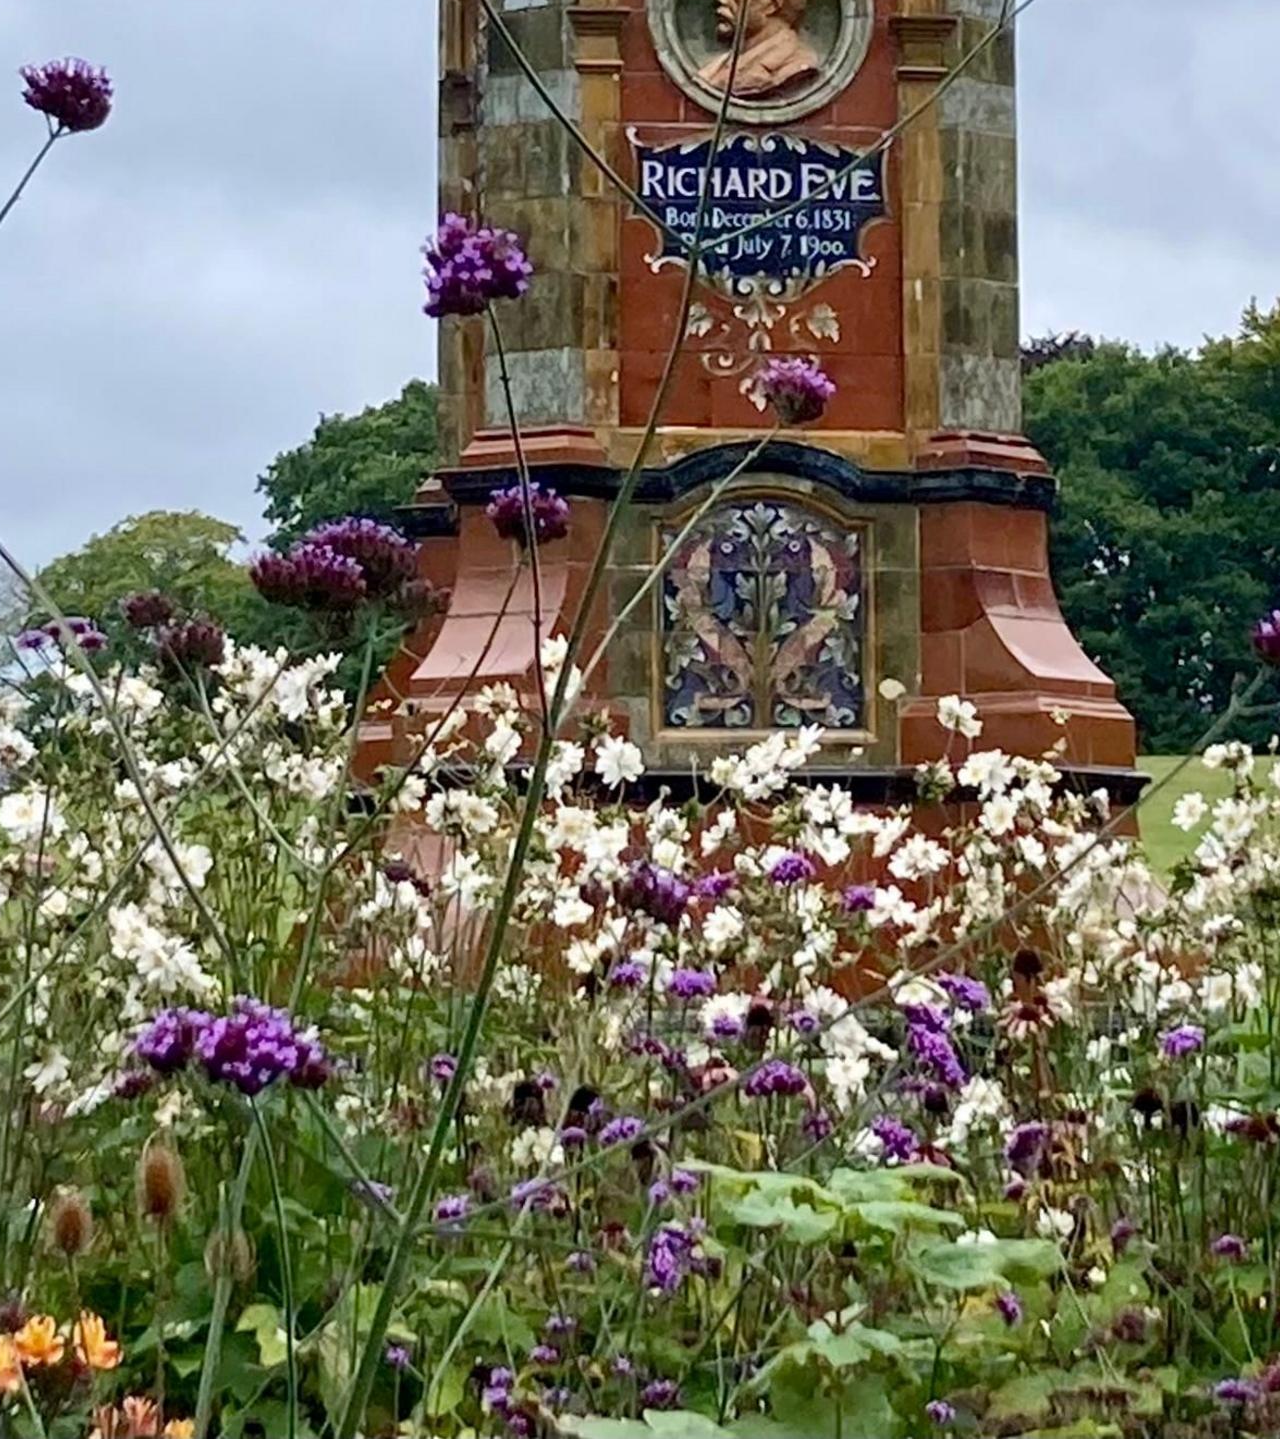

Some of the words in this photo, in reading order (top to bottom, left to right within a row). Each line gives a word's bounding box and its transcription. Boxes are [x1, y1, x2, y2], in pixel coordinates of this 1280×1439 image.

[642, 160, 793, 202] RICHARD
[800, 163, 881, 200] EVE
[730, 234, 774, 260] July
